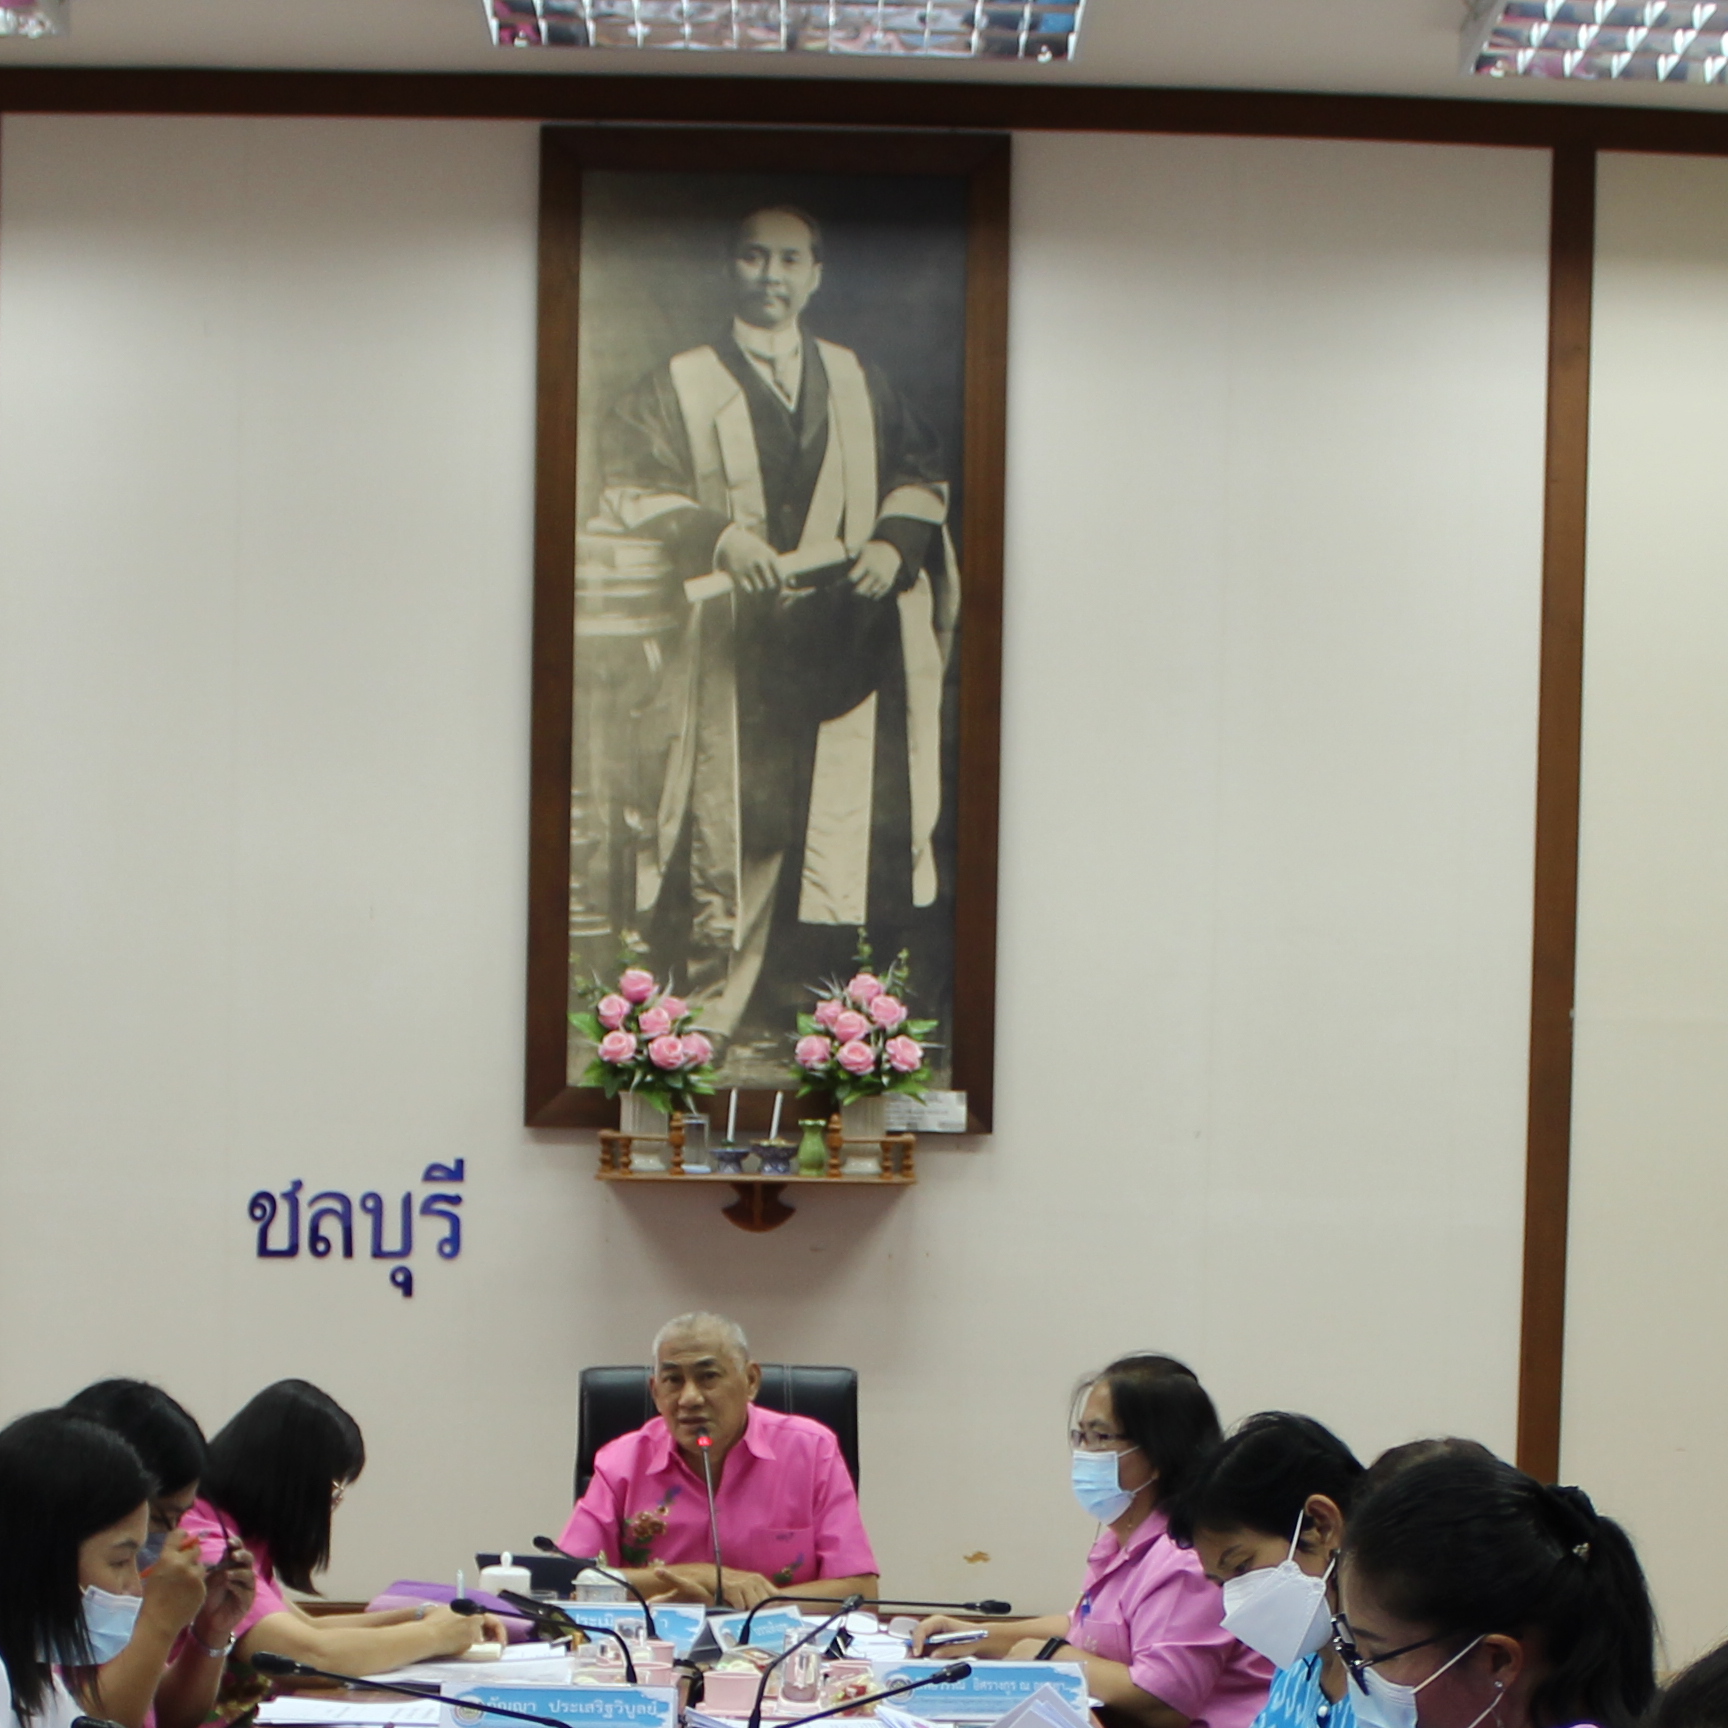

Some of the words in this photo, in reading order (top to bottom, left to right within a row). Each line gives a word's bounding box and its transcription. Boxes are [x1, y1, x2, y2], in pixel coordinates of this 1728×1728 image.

[248, 1158, 464, 1298] ชลบุรี
[549, 1698, 659, 1719] ประเสริฐวิบูลย์
